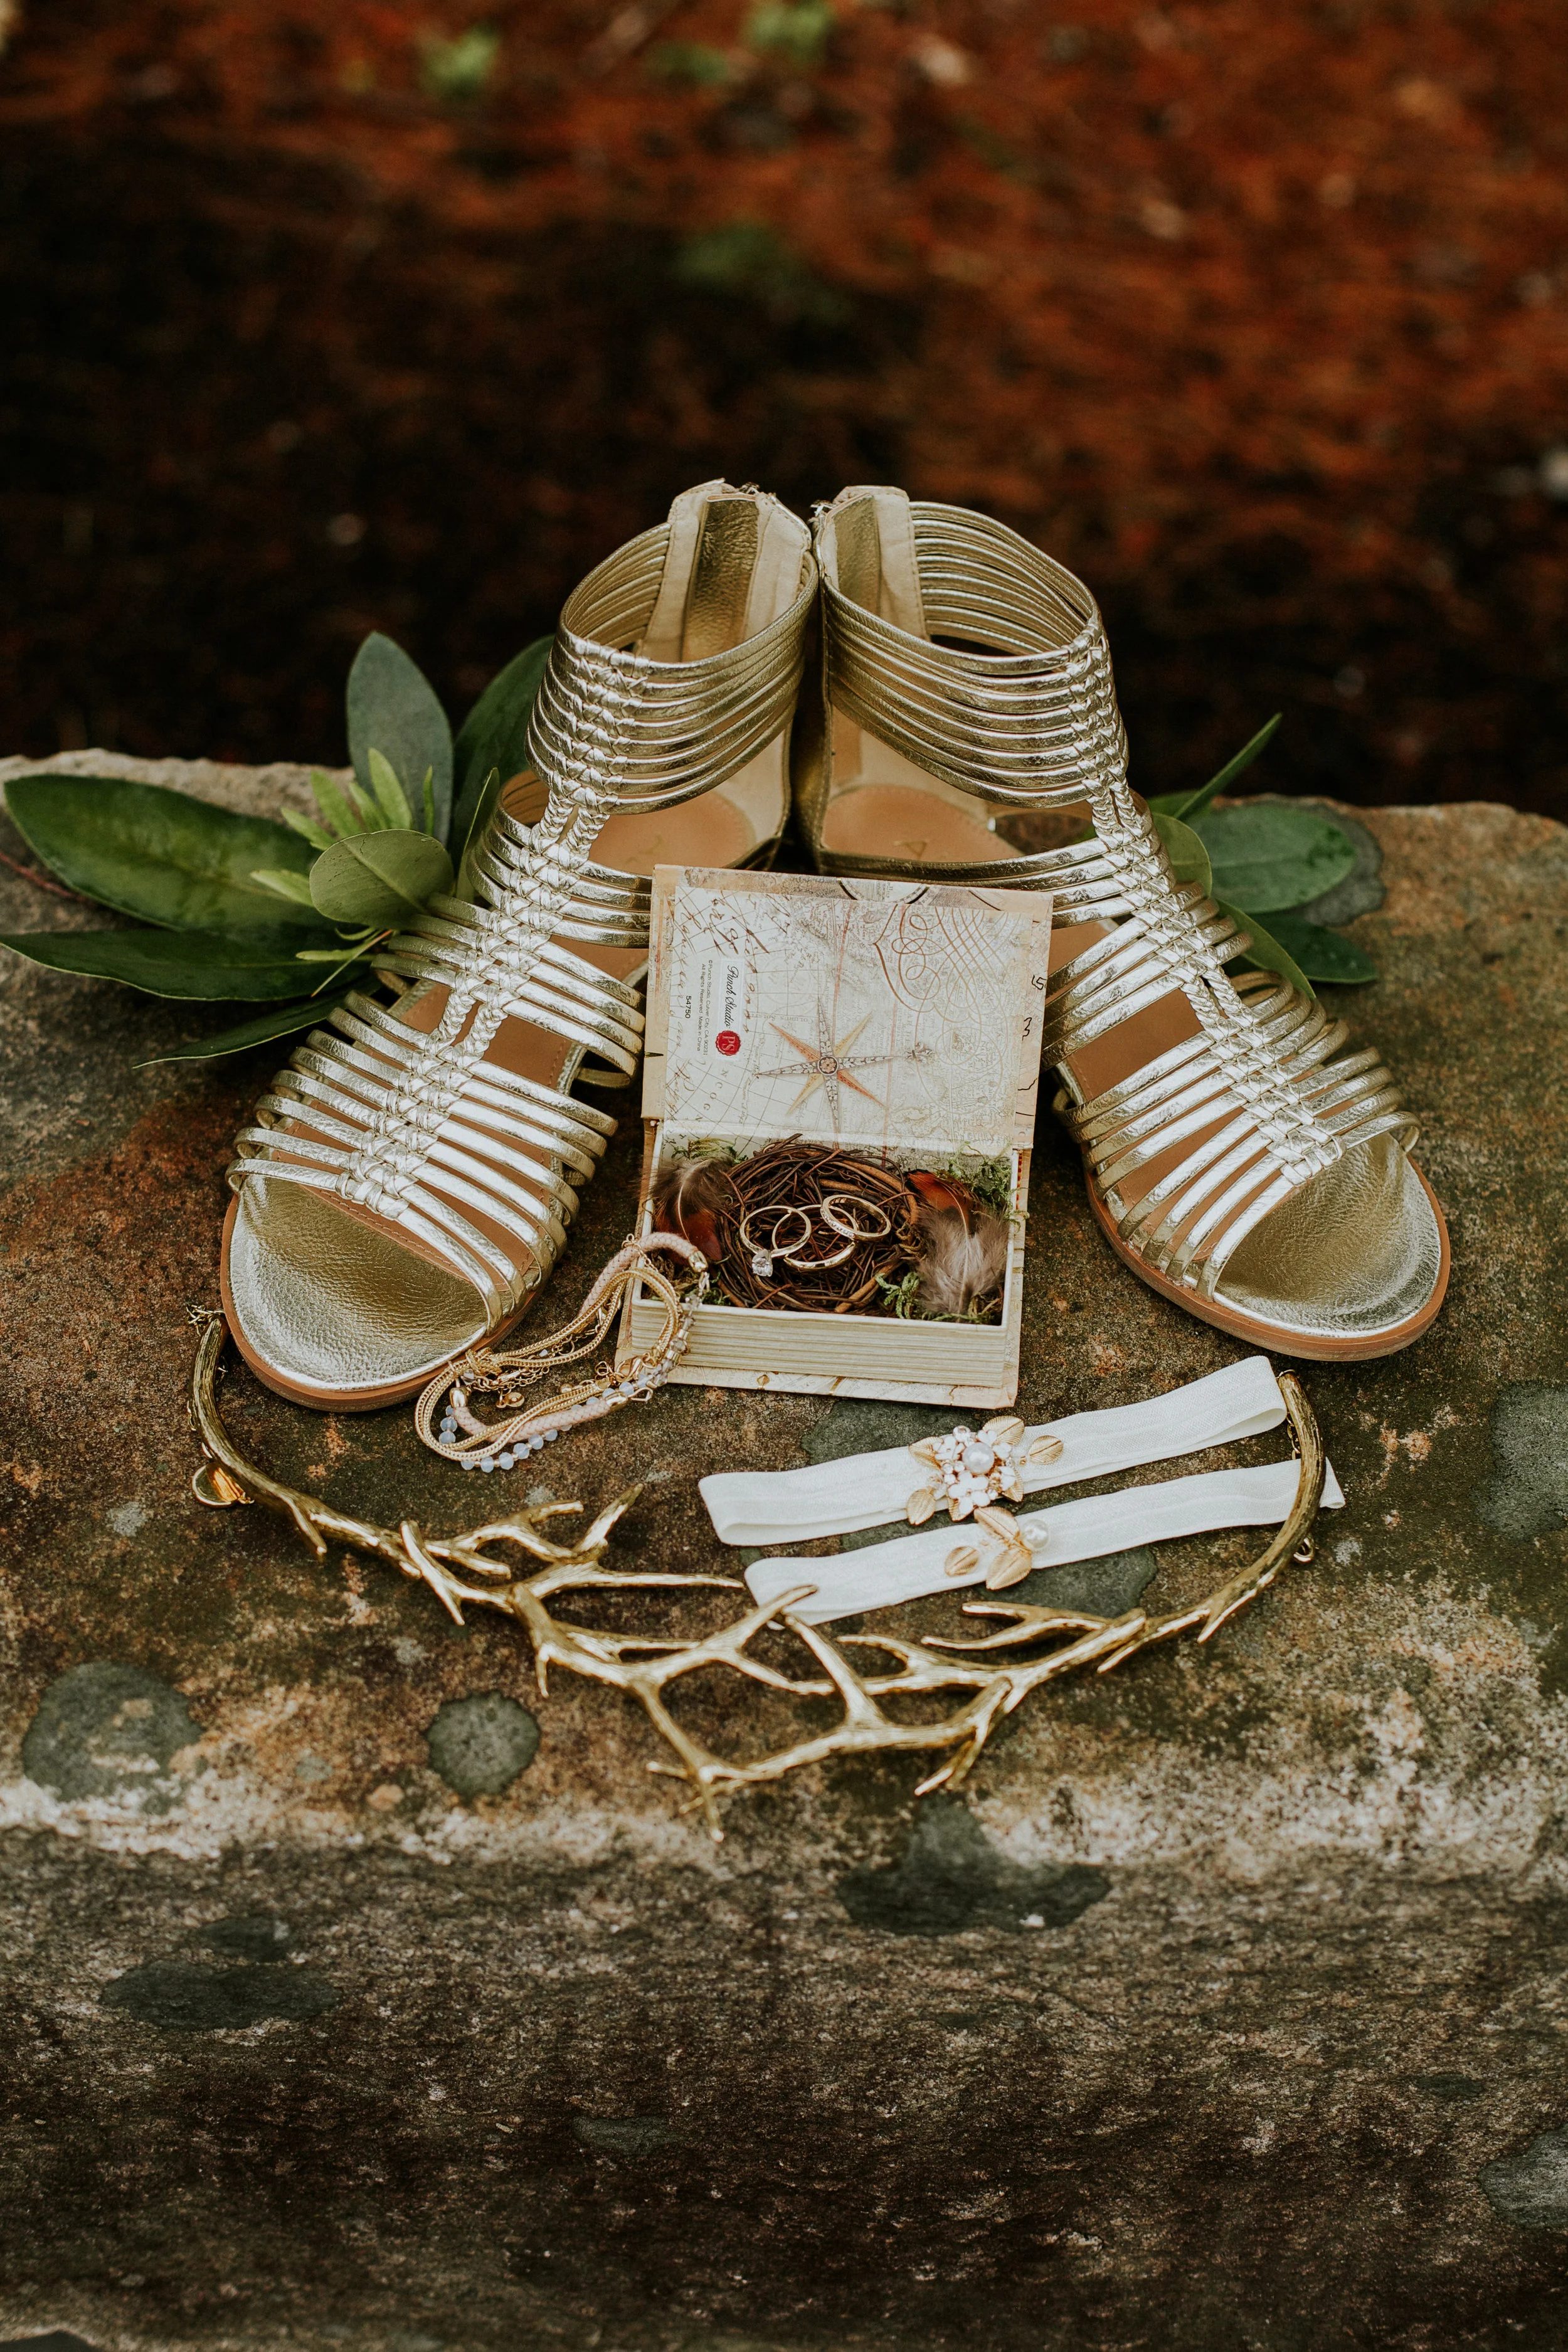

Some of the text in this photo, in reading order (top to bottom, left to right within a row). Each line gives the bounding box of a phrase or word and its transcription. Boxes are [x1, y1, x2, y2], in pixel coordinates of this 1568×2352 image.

[726, 965, 739, 995] Punch
[724, 997, 737, 1028] Studio
[704, 1030, 709, 1038] CA
[721, 1036, 735, 1051] PS
